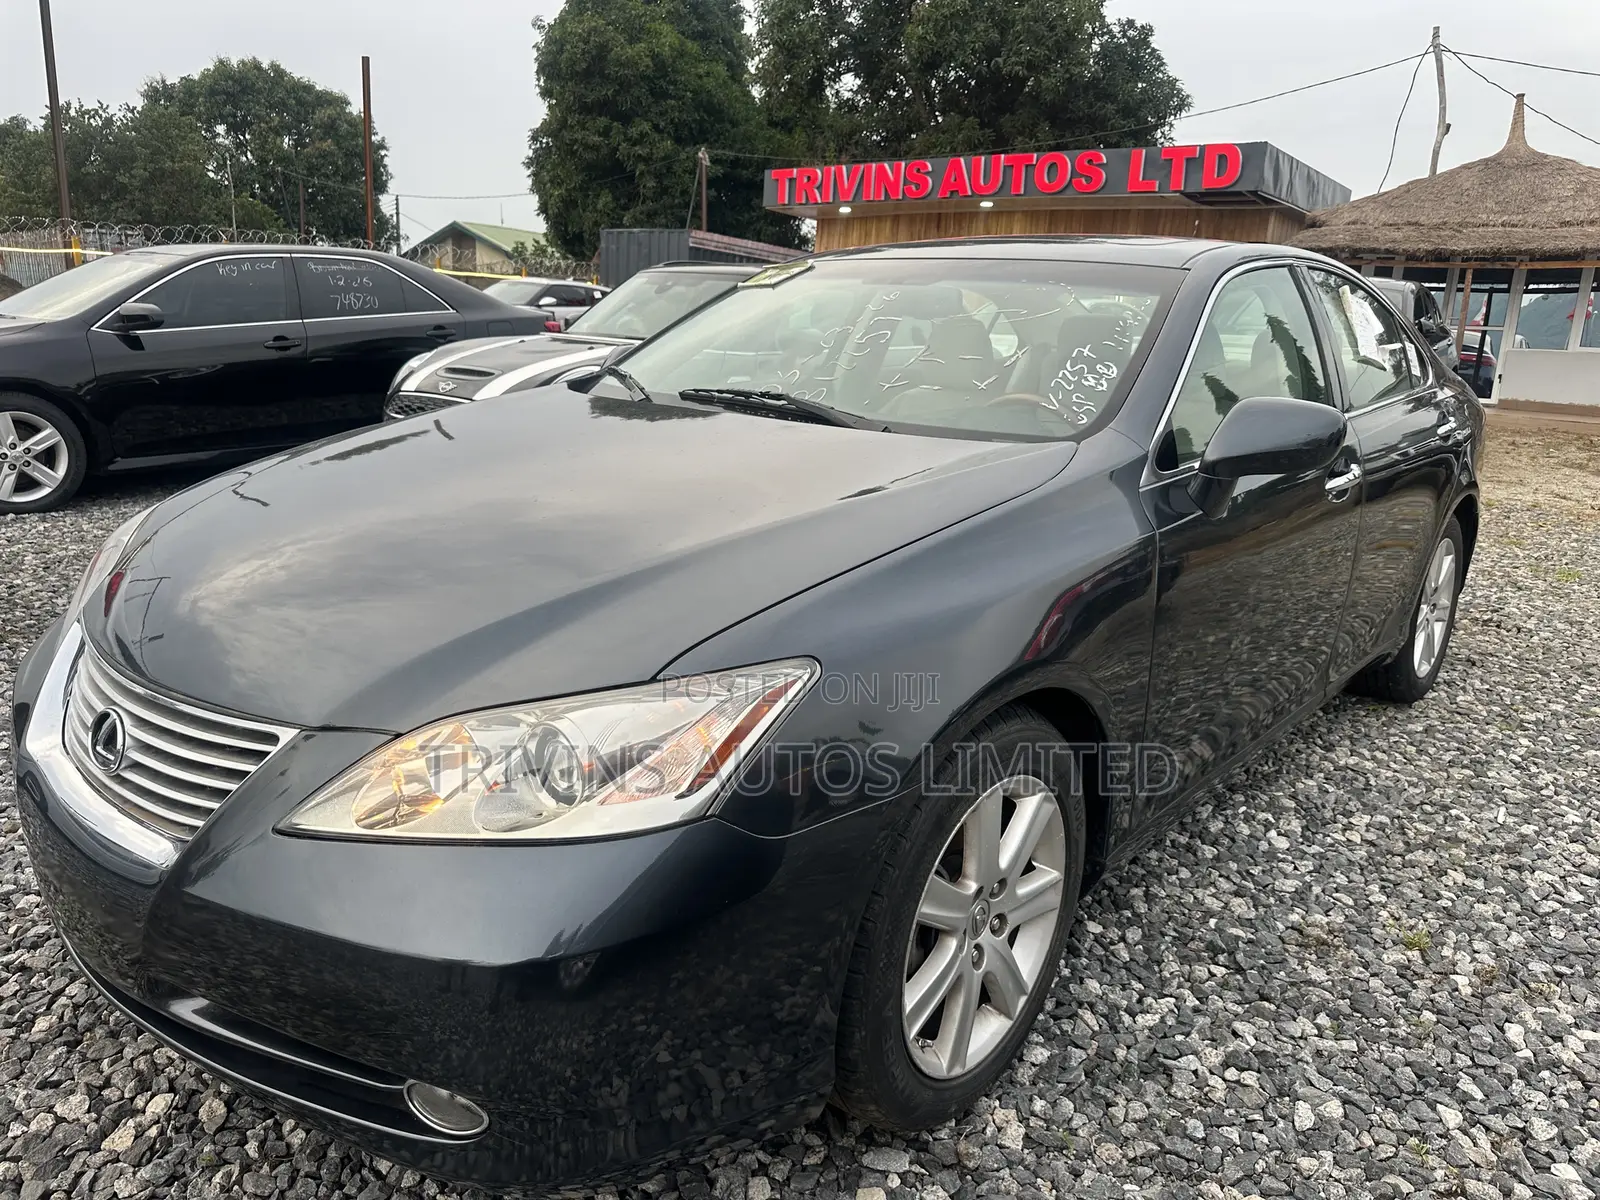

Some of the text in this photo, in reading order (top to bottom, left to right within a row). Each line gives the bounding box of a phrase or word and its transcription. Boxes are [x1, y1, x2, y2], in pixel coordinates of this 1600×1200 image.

[771, 143, 1243, 205] TRIVINS AUTOS LTD
